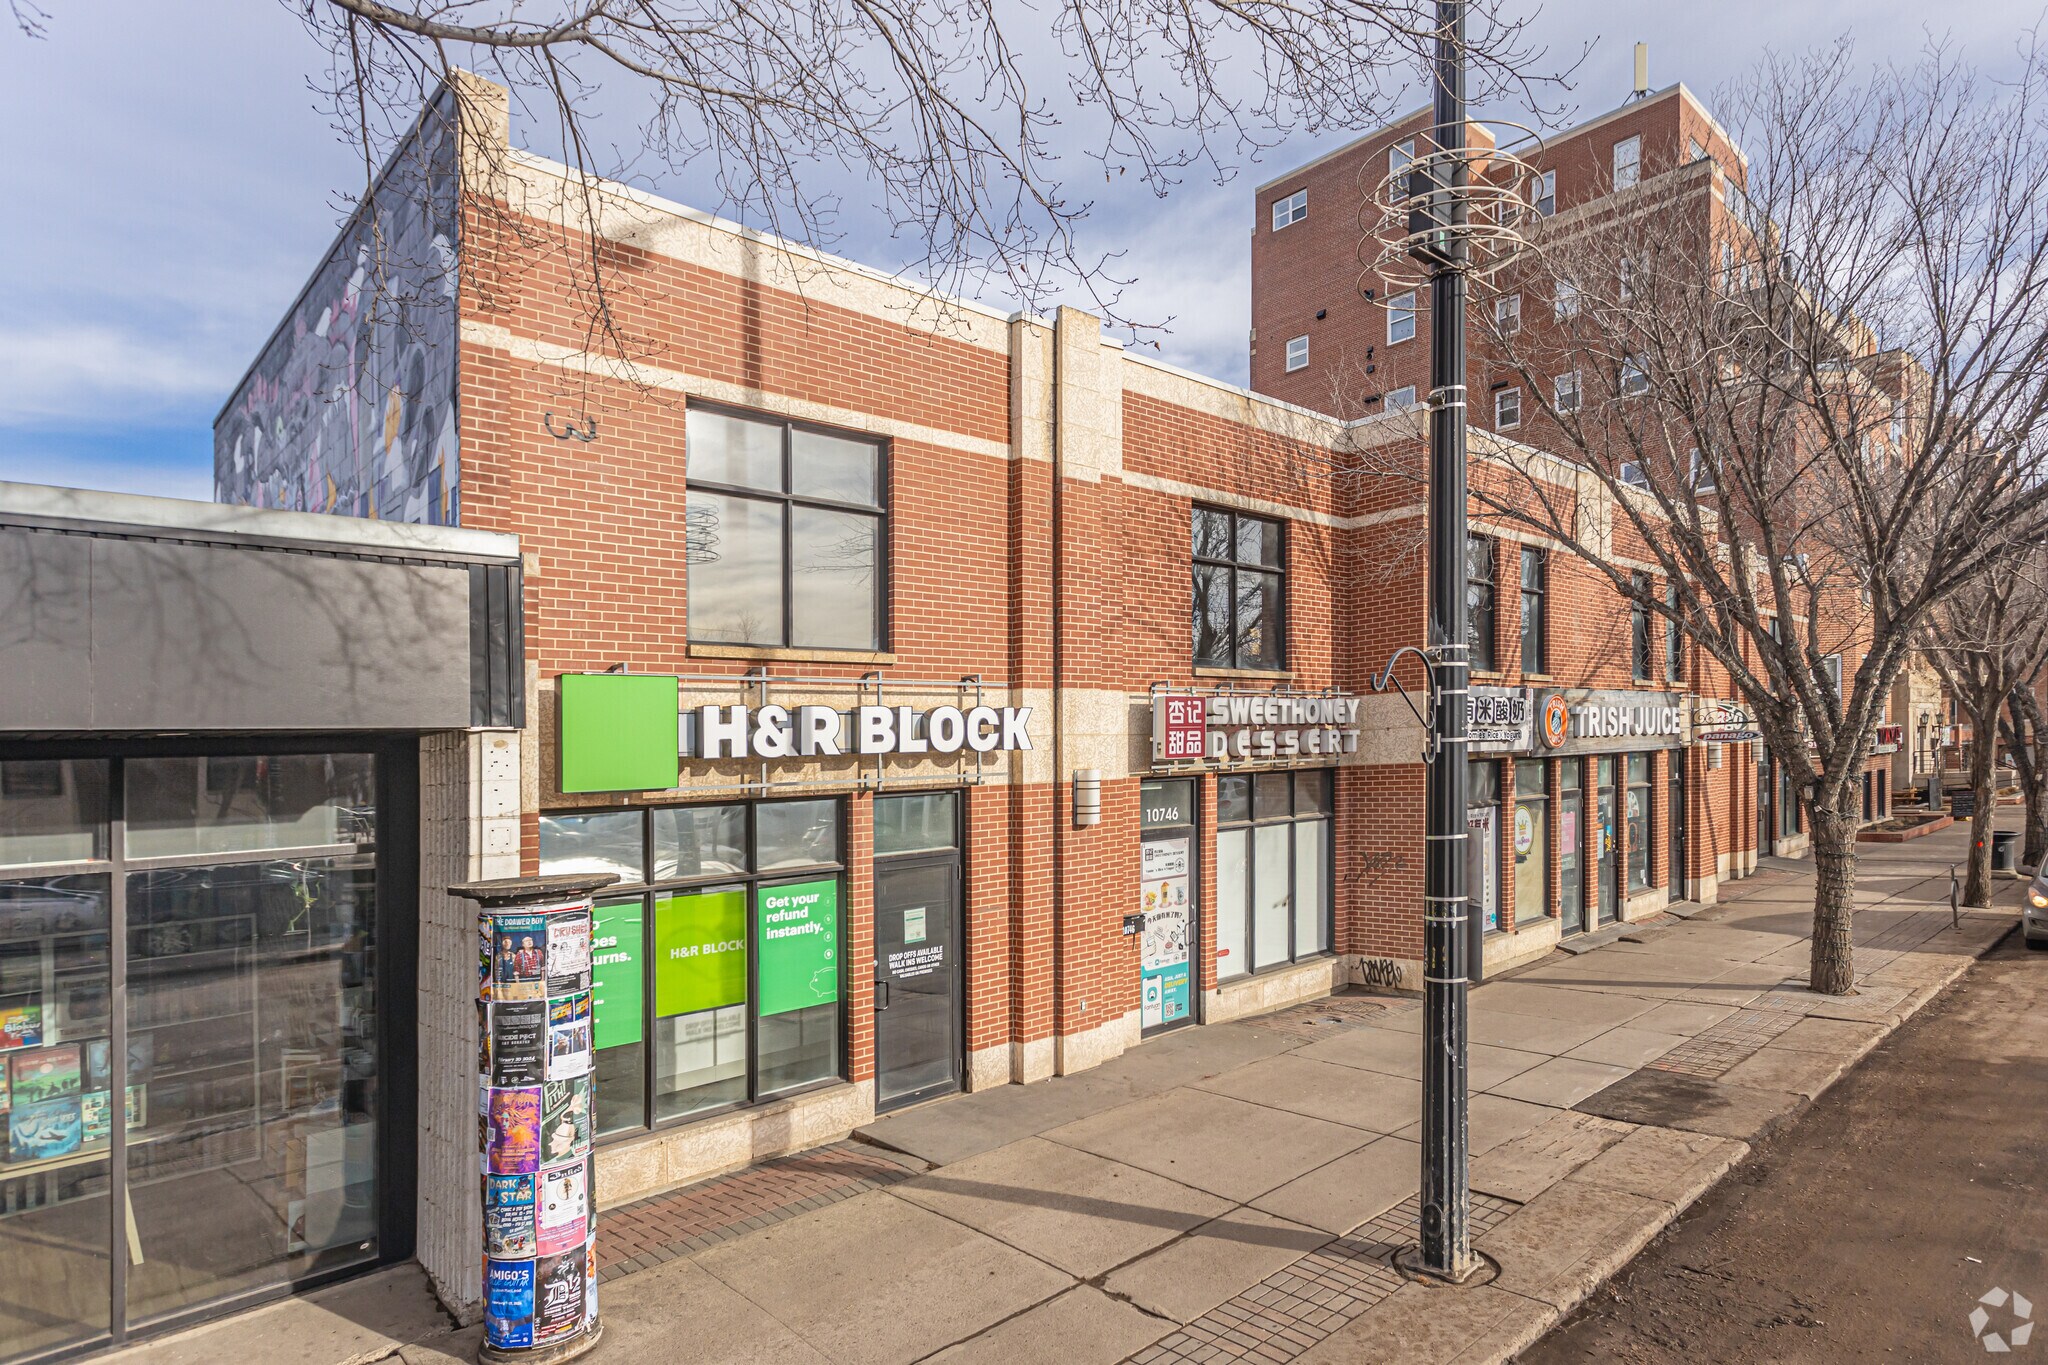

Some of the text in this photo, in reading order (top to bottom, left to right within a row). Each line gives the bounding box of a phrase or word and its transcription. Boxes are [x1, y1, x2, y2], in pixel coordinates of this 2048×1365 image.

[1168, 700, 1202, 725] 杏记
[1211, 698, 1361, 726] SWEETHONEY
[1573, 705, 1630, 737] TRISH
[1634, 706, 1680, 736] JUICE
[702, 704, 1034, 759] H&R BLOCK
[1702, 730, 1755, 741] panago
[1168, 730, 1202, 755] 甜品
[1211, 729, 1361, 756] DESSERT
[1146, 807, 1179, 822] 10746
[766, 893, 820, 909] Get your
[504, 917, 531, 926] DRAWER
[531, 917, 544, 925] BOY
[766, 906, 809, 923] refund
[766, 921, 824, 940] instantly.
[670, 939, 745, 960] H&R BLOCK
[888, 945, 944, 962] DROP OFFS AVAILABLE
[888, 952, 944, 969] WALK INS WELCOME
[489, 1178, 517, 1190] DARK
[500, 1191, 533, 1204] STAR
[489, 1269, 530, 1281] AMIGO'S
